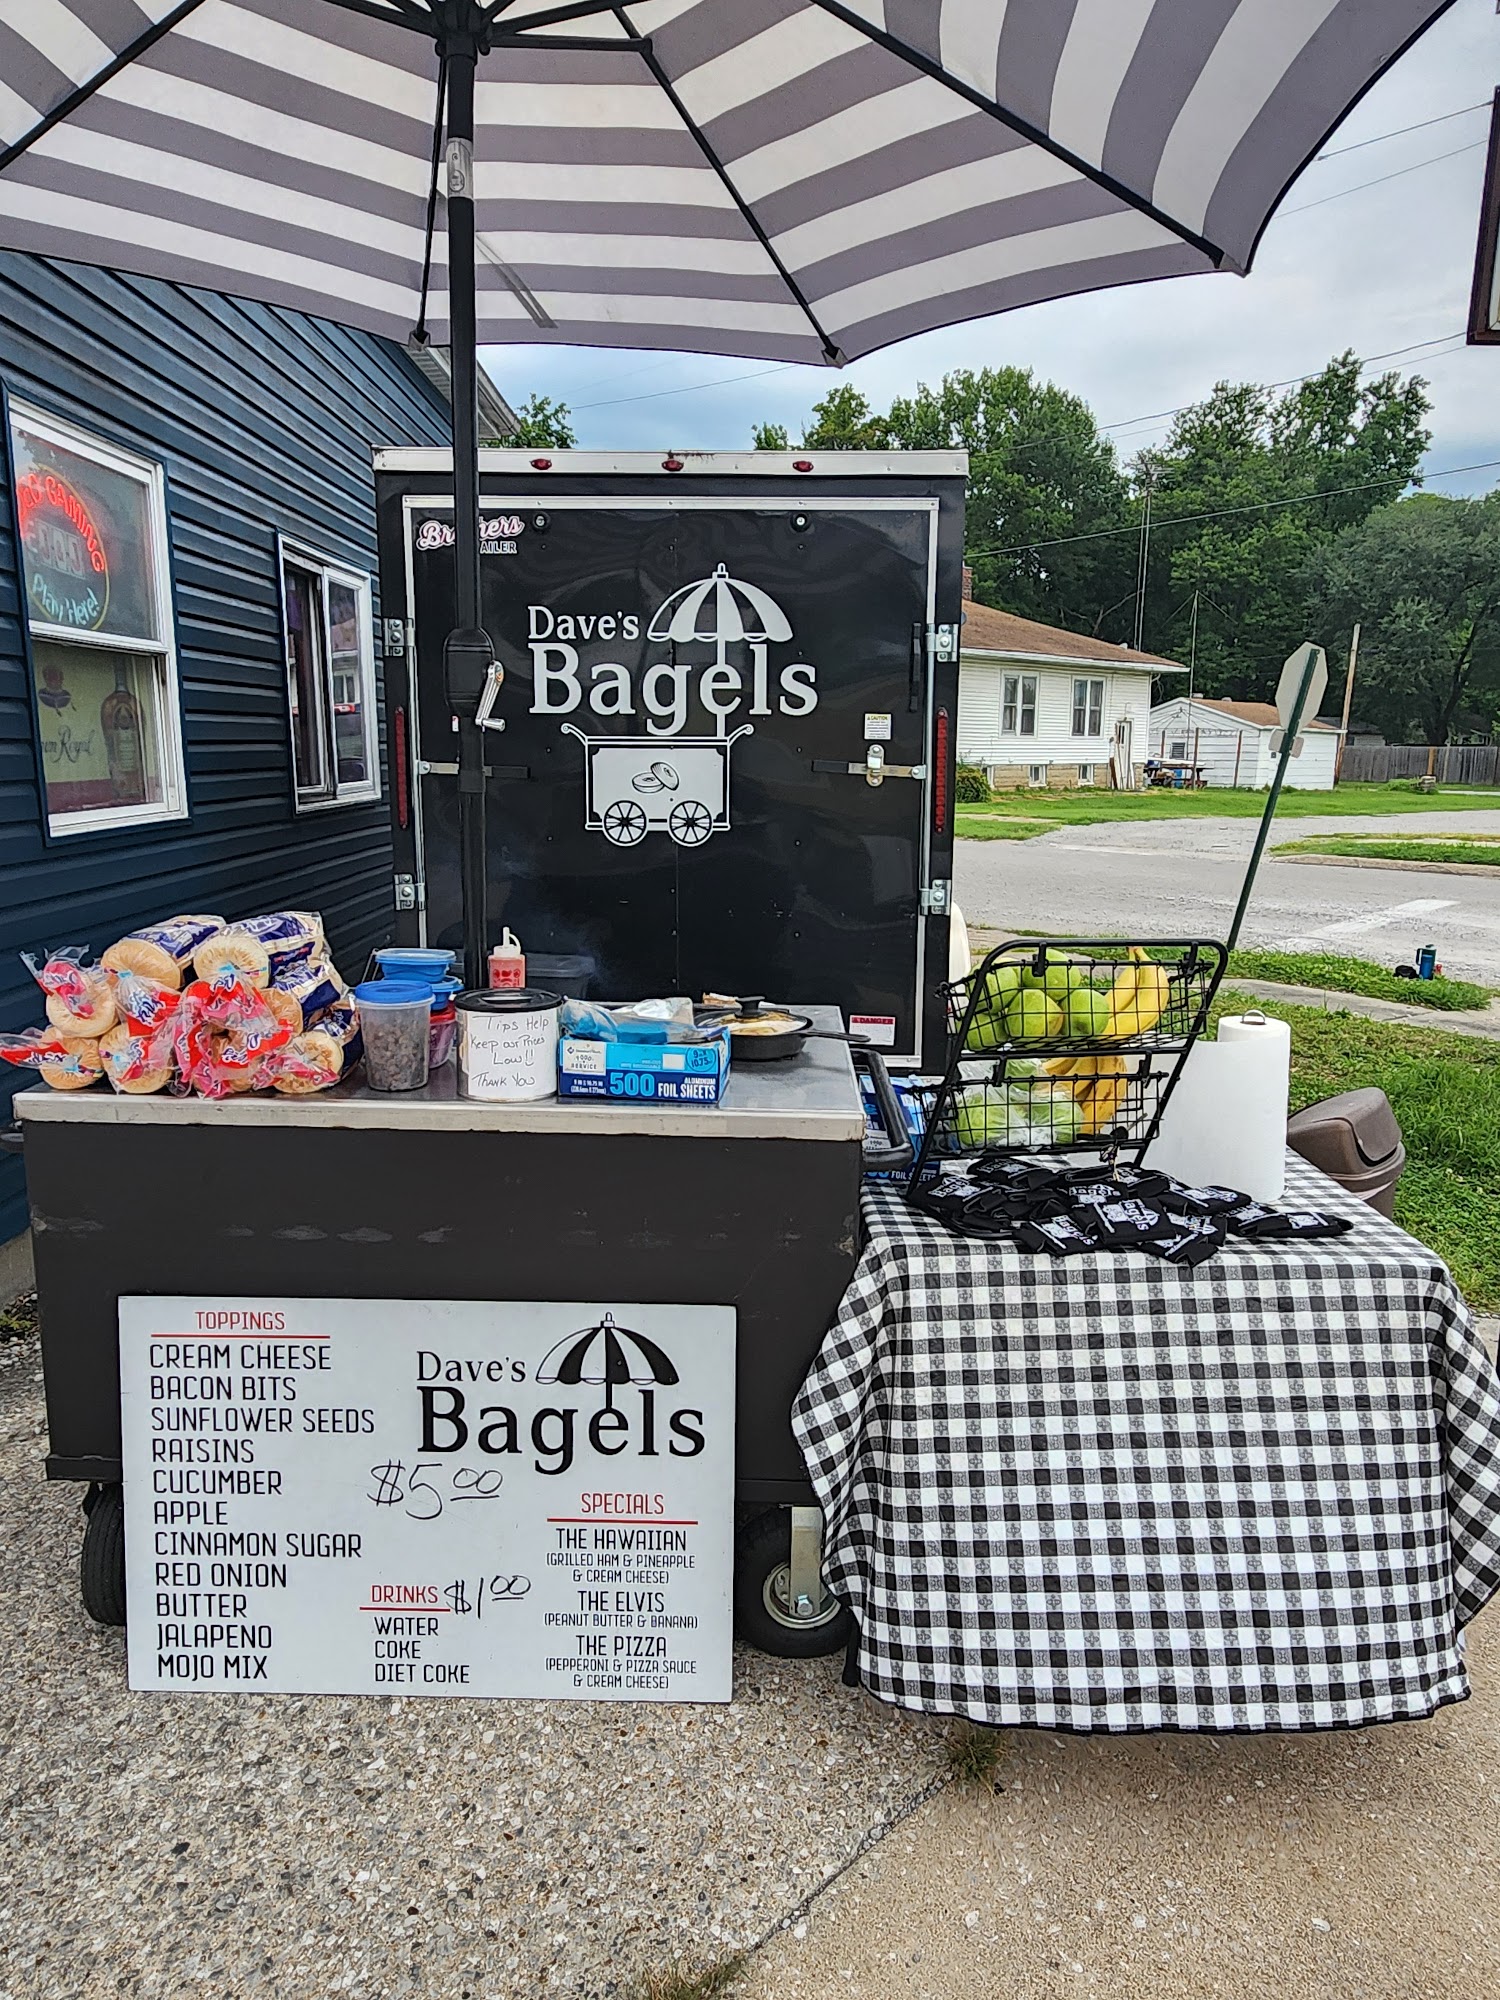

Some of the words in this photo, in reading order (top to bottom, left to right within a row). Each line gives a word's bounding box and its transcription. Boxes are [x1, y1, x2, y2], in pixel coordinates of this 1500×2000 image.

[45, 475, 105, 572] GAMING
[480, 541, 517, 554] AILER
[527, 605, 640, 640] Dave's
[527, 642, 819, 736] Bagels
[472, 1014, 519, 1033] Tips
[526, 1015, 549, 1031] Help
[470, 1034, 499, 1053] Keep
[610, 1072, 655, 1097] 500
[657, 1082, 679, 1098] FOIL
[680, 1084, 716, 1100] SHEETS
[891, 1170, 907, 1180] FOIL
[194, 1311, 285, 1331] TOPPINGS
[149, 1343, 231, 1370] CREAM
[240, 1344, 332, 1370] CHEESE
[416, 1350, 527, 1383] Dave's
[150, 1375, 232, 1401] BACON
[241, 1375, 297, 1401] BITS
[151, 1406, 294, 1433] SUNFLOWER
[302, 1408, 375, 1434] SEEDS
[416, 1385, 706, 1475] Bagels
[151, 1437, 255, 1464] RAISINS
[152, 1469, 283, 1496] CUCUMBER
[153, 1500, 229, 1526] APPLE
[581, 1492, 664, 1515] SPECIALS
[154, 1531, 277, 1557] CINNAMON
[285, 1532, 362, 1559] SUGAR
[555, 1527, 588, 1550] THE
[594, 1528, 687, 1552] HAWAIIAN
[546, 1552, 595, 1567] (GRILLED
[597, 1553, 620, 1568] HAM
[622, 1553, 633, 1568] &
[636, 1554, 696, 1569] PINEAPPLE
[155, 1562, 201, 1587] RED
[210, 1562, 287, 1589] ONION
[572, 1568, 583, 1583] &
[586, 1569, 622, 1584] CREAM
[625, 1569, 670, 1585] CHEESE)
[156, 1592, 248, 1619] BUTTER
[371, 1584, 439, 1604] DRINKS
[576, 1590, 610, 1612] THE
[615, 1591, 665, 1613] ELVIS
[373, 1616, 439, 1637] WATER
[544, 1612, 590, 1627] (PEANUT
[592, 1613, 633, 1628] BUTTER
[637, 1614, 647, 1628] &
[650, 1614, 698, 1630] BANANA)
[156, 1623, 272, 1651] JALAPENO
[575, 1634, 608, 1657] THE
[613, 1635, 667, 1658] PIZZA
[374, 1640, 422, 1660] COKE
[157, 1653, 214, 1682] MOJO
[223, 1654, 268, 1680] MIX
[374, 1663, 417, 1683] DIET
[423, 1664, 470, 1684] COKE
[545, 1657, 609, 1672] (PEPPERONI
[612, 1658, 623, 1673] &
[626, 1659, 659, 1674] PIZZA
[662, 1659, 697, 1675] SAUCE
[573, 1673, 584, 1687] &
[586, 1674, 622, 1689] CREAM
[625, 1675, 669, 1690] CHEESE)
